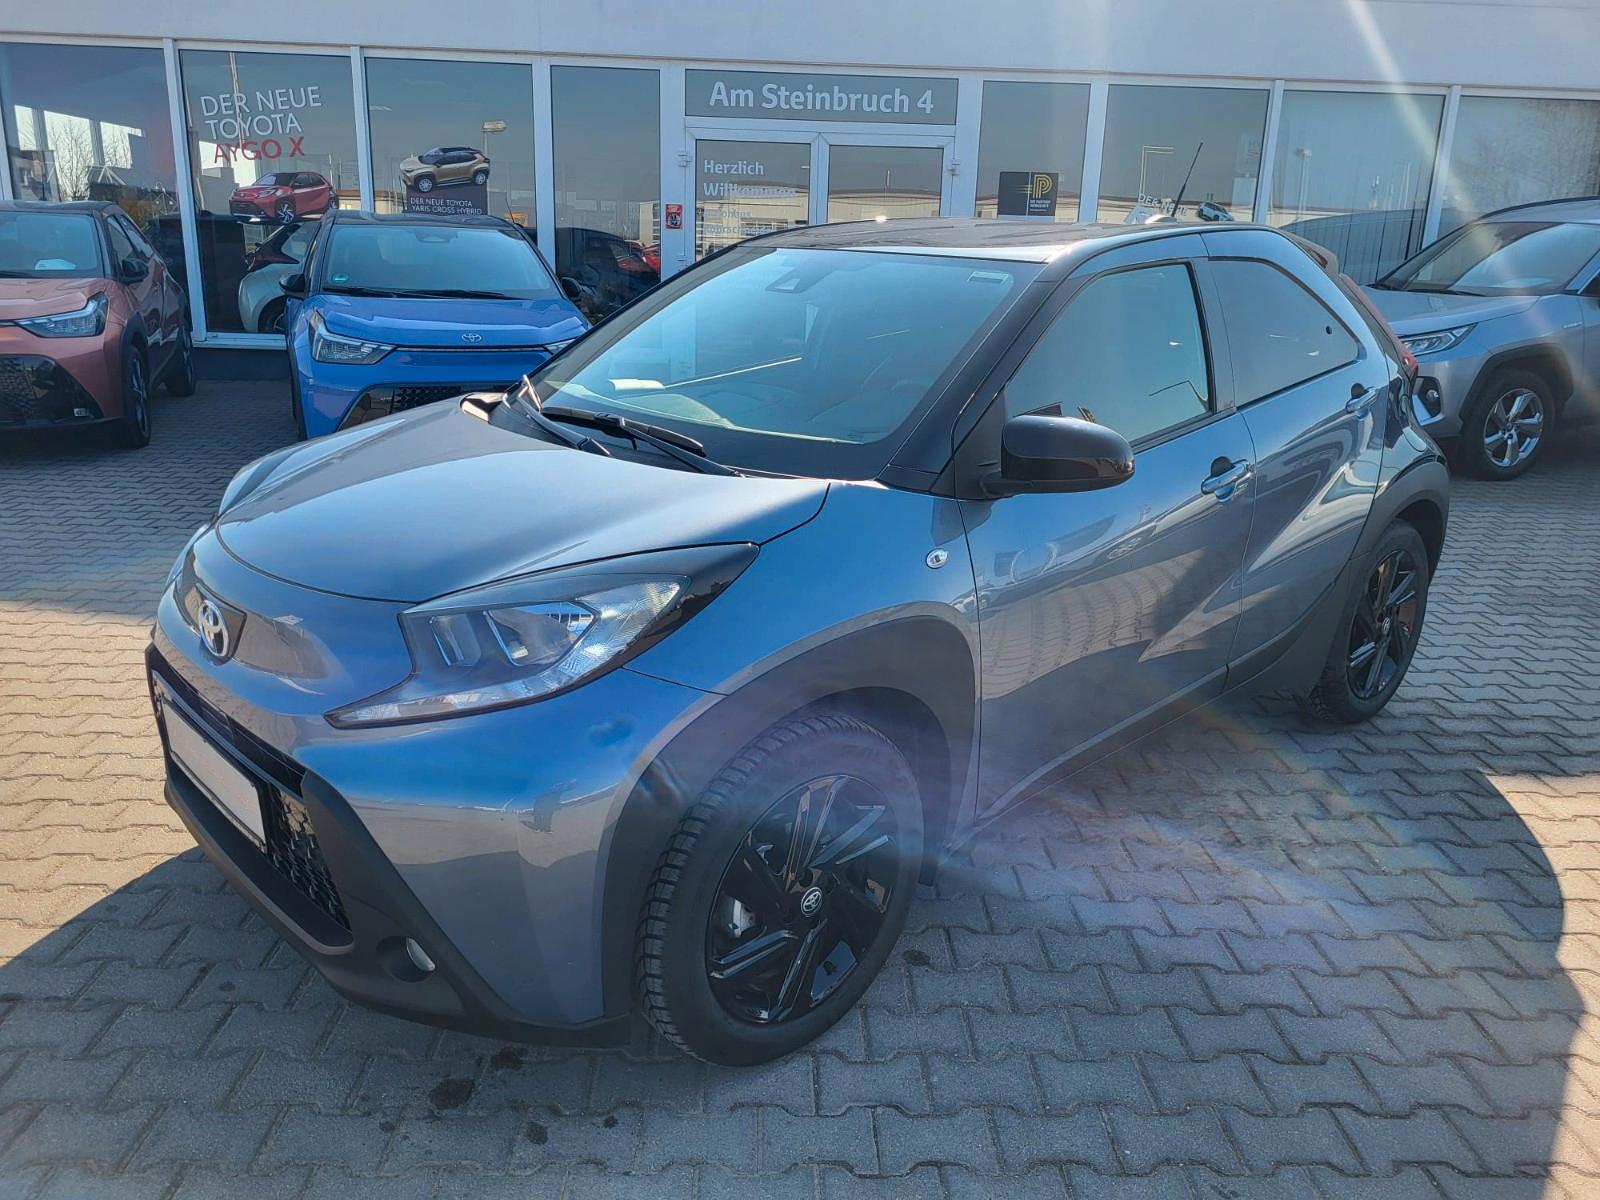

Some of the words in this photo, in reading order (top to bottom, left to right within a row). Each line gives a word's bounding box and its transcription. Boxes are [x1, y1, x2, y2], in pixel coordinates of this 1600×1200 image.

[200, 93, 250, 116] DER
[256, 86, 322, 111] NEUE
[709, 81, 754, 107] Am
[761, 83, 909, 113] Steinbruch
[917, 89, 934, 114] 4
[205, 112, 302, 140] TOYOTA
[214, 138, 282, 163] AYGO
[288, 136, 305, 158] X
[704, 160, 764, 175] Herzlich
[410, 197, 424, 205] DER
[425, 198, 445, 206] NEUE
[446, 199, 472, 207] TOYOTA
[432, 206, 455, 214] CROSS
[457, 207, 482, 215] HYBRID
